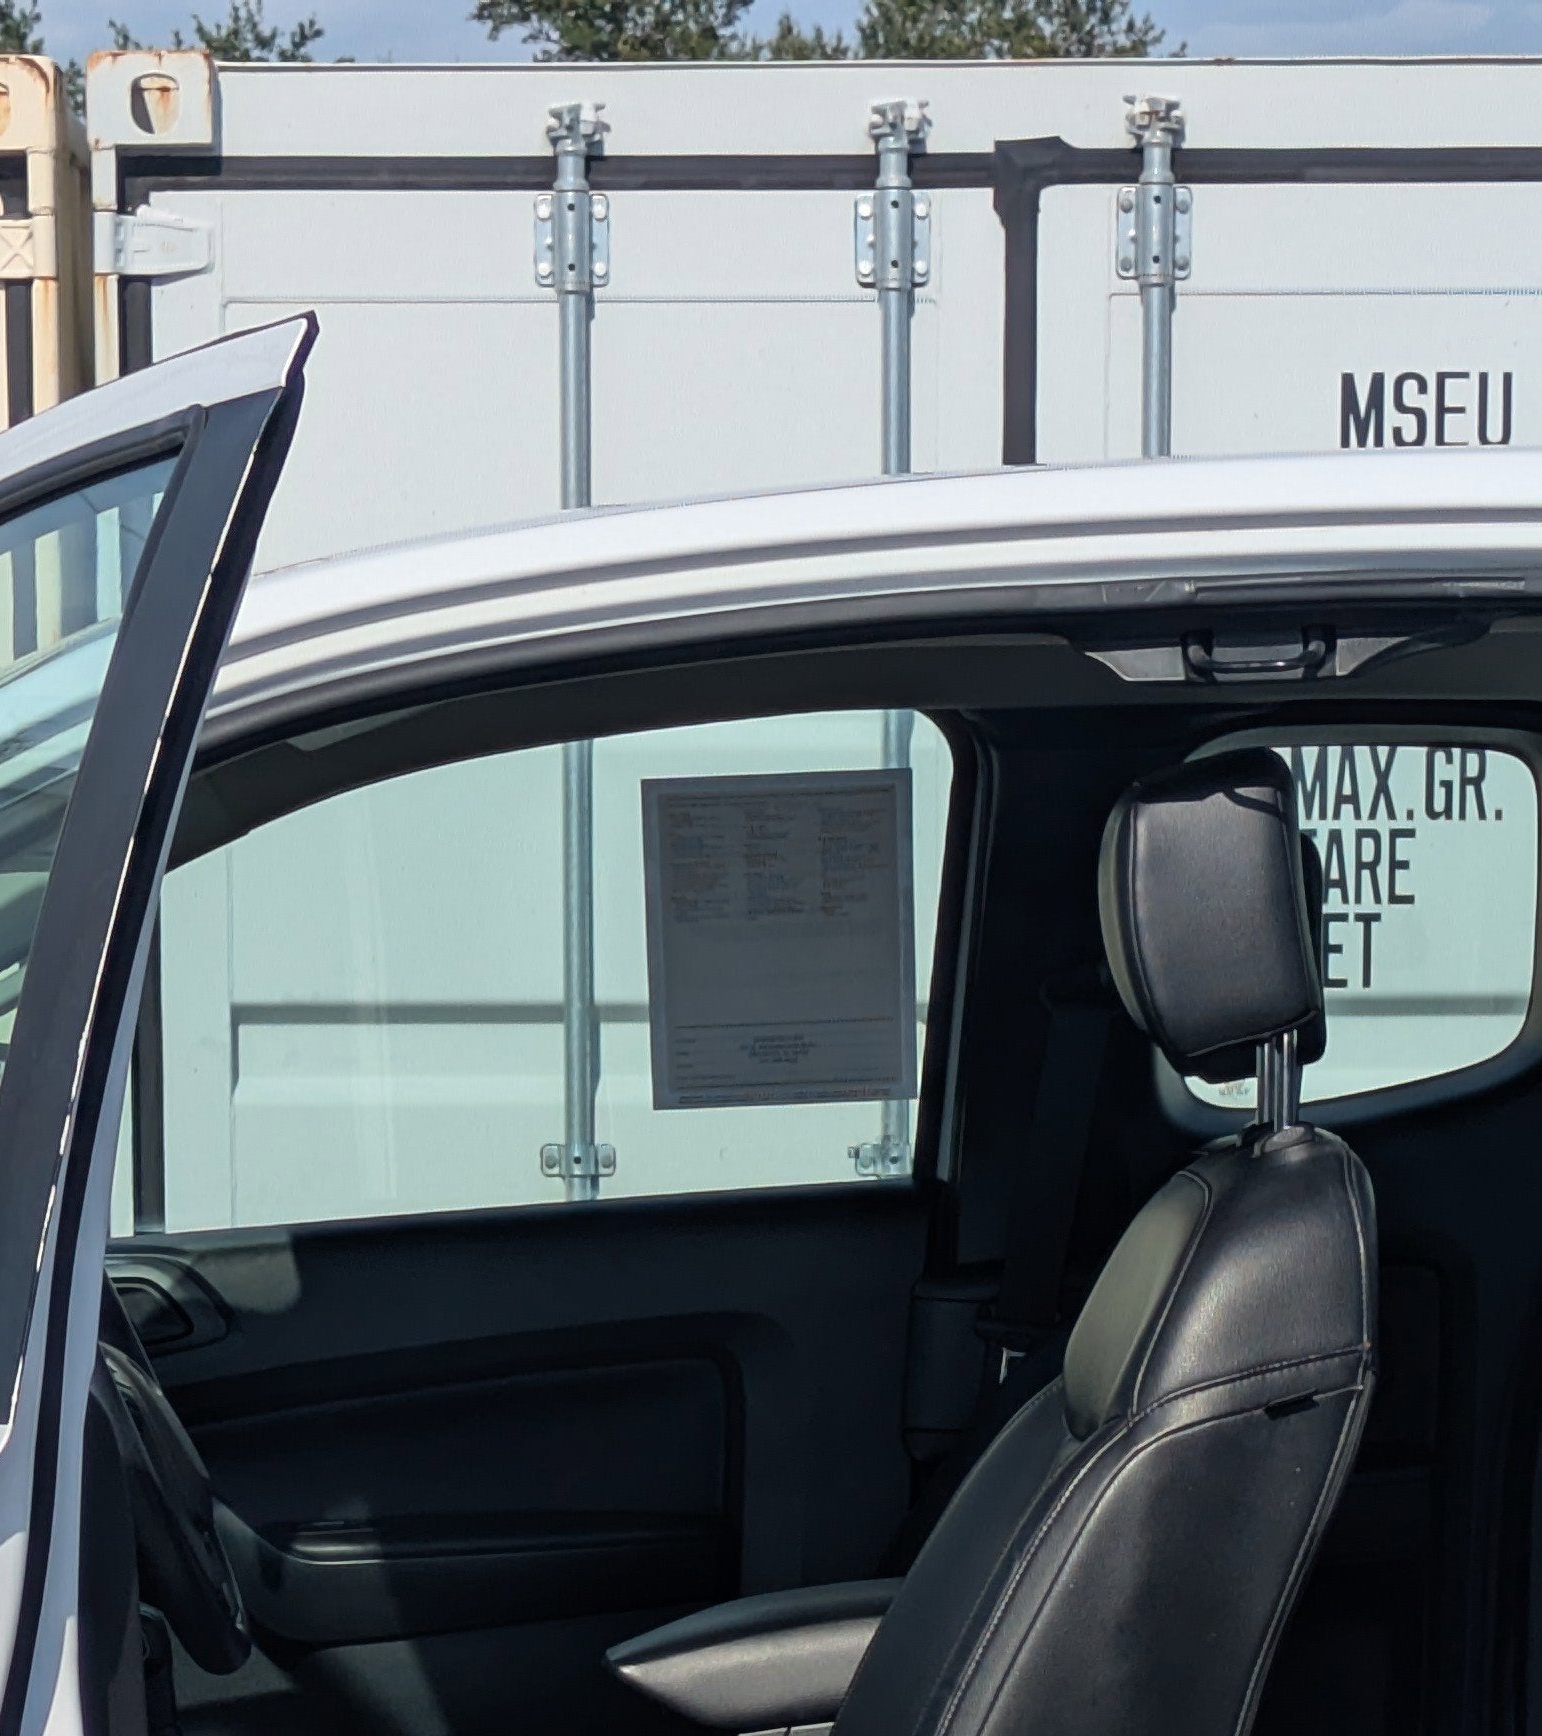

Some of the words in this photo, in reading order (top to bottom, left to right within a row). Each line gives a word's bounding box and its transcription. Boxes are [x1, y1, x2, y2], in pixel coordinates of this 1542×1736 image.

[1340, 371, 1512, 448] MSEU
[1300, 828, 1416, 905] ARE
[1322, 912, 1381, 988] ET
